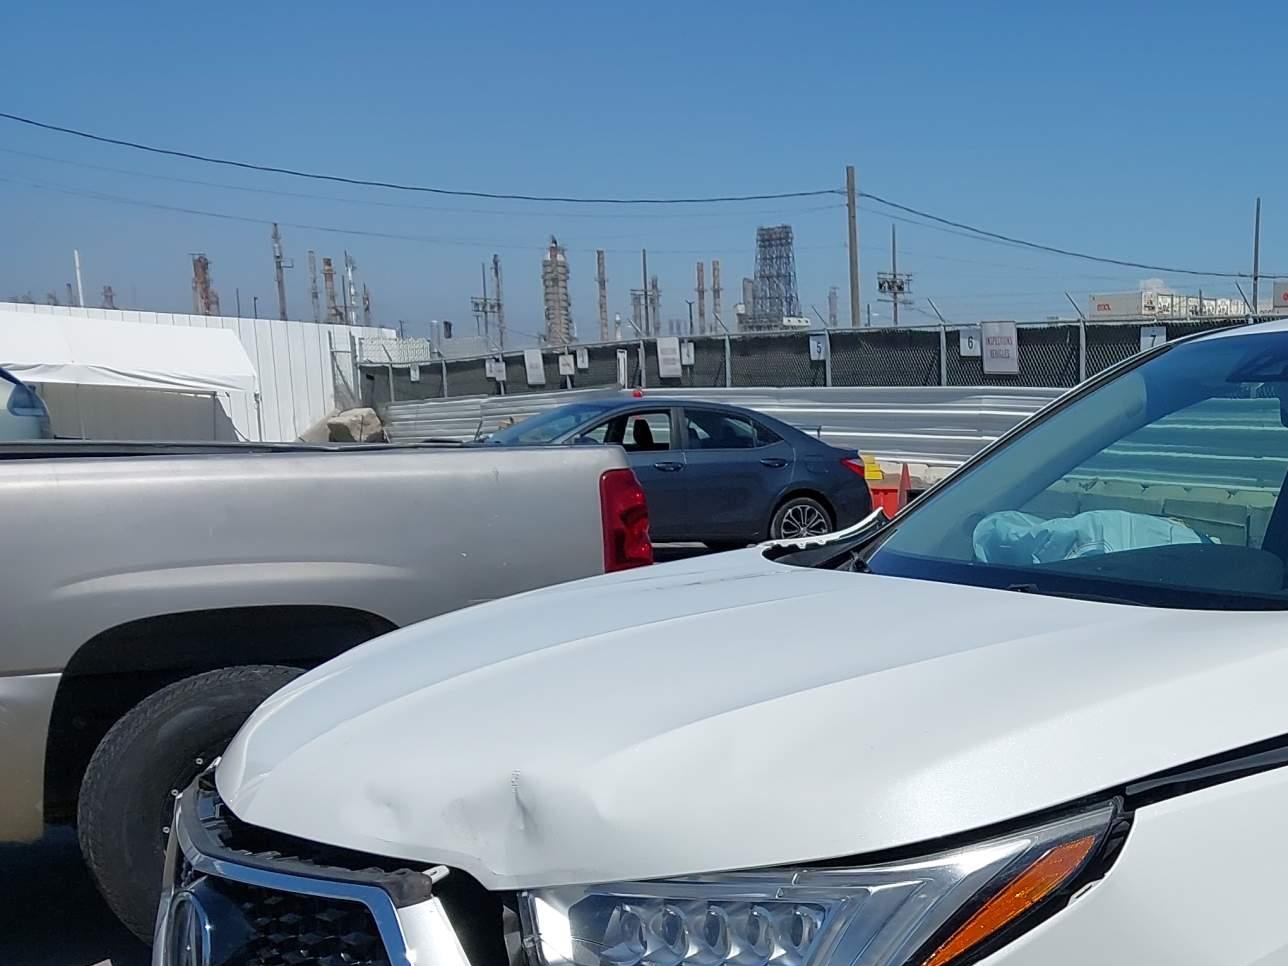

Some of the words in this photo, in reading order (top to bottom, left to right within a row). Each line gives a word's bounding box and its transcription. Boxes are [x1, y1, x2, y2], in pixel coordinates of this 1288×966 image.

[816, 342, 822, 354] 5
[967, 335, 974, 349] 6
[1150, 334, 1157, 348] 7
